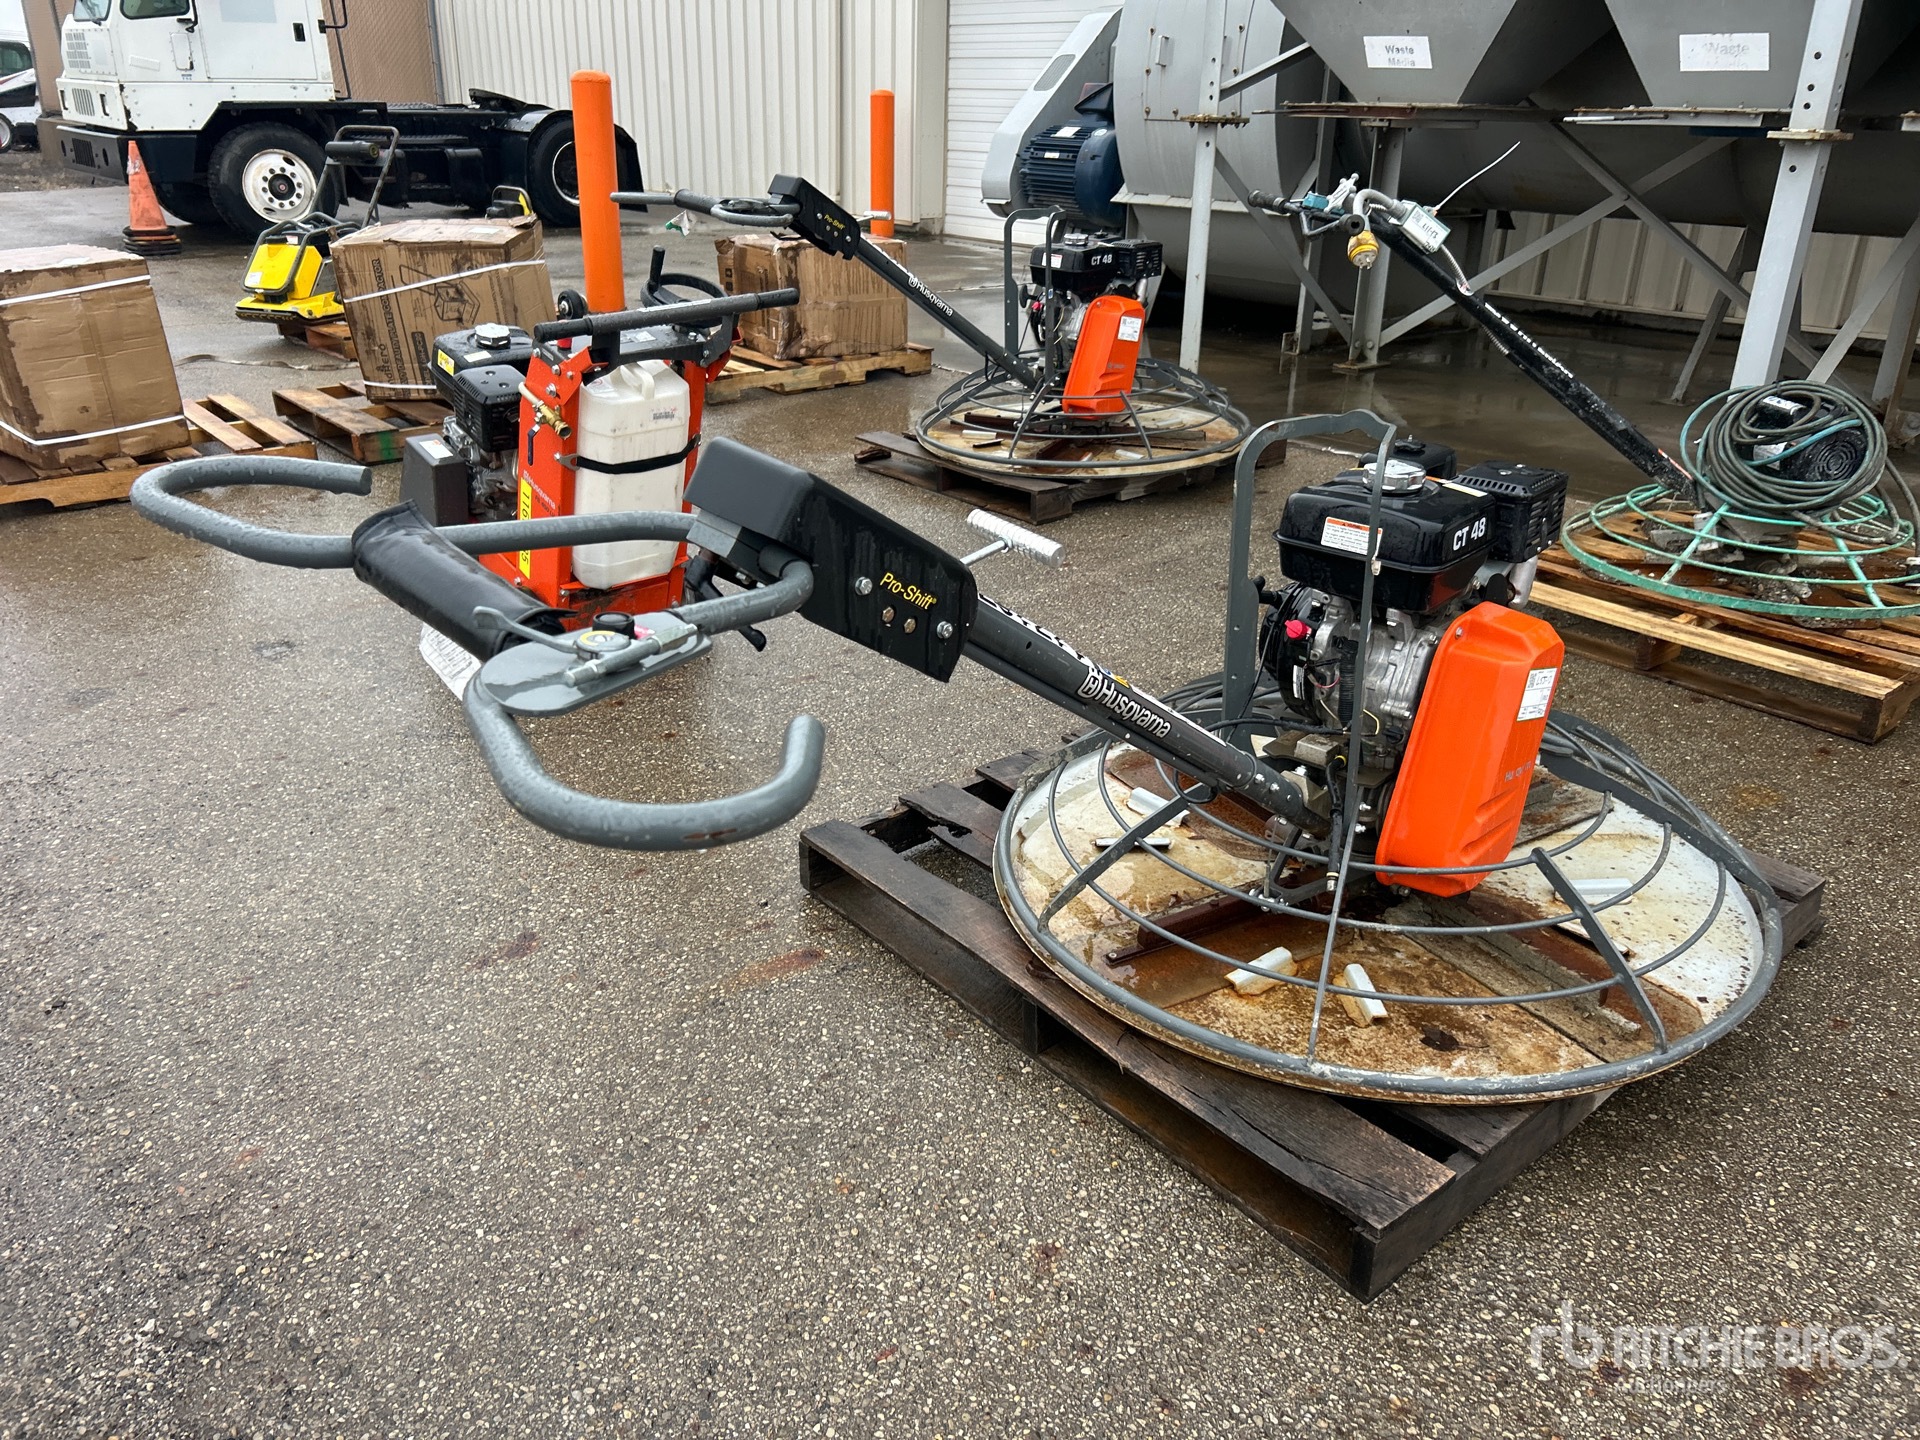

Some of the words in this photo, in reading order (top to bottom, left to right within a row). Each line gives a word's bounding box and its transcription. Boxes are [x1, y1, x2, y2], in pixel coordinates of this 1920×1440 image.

[1385, 45, 1415, 54] Waste
[1091, 256, 1100, 266] CT
[1102, 254, 1112, 264] 48
[916, 280, 954, 317] Husqvarna
[384, 312, 398, 339] PLATE
[1452, 526, 1470, 551] CT
[1470, 516, 1486, 540] 48
[1096, 678, 1172, 739] Husqvarna
